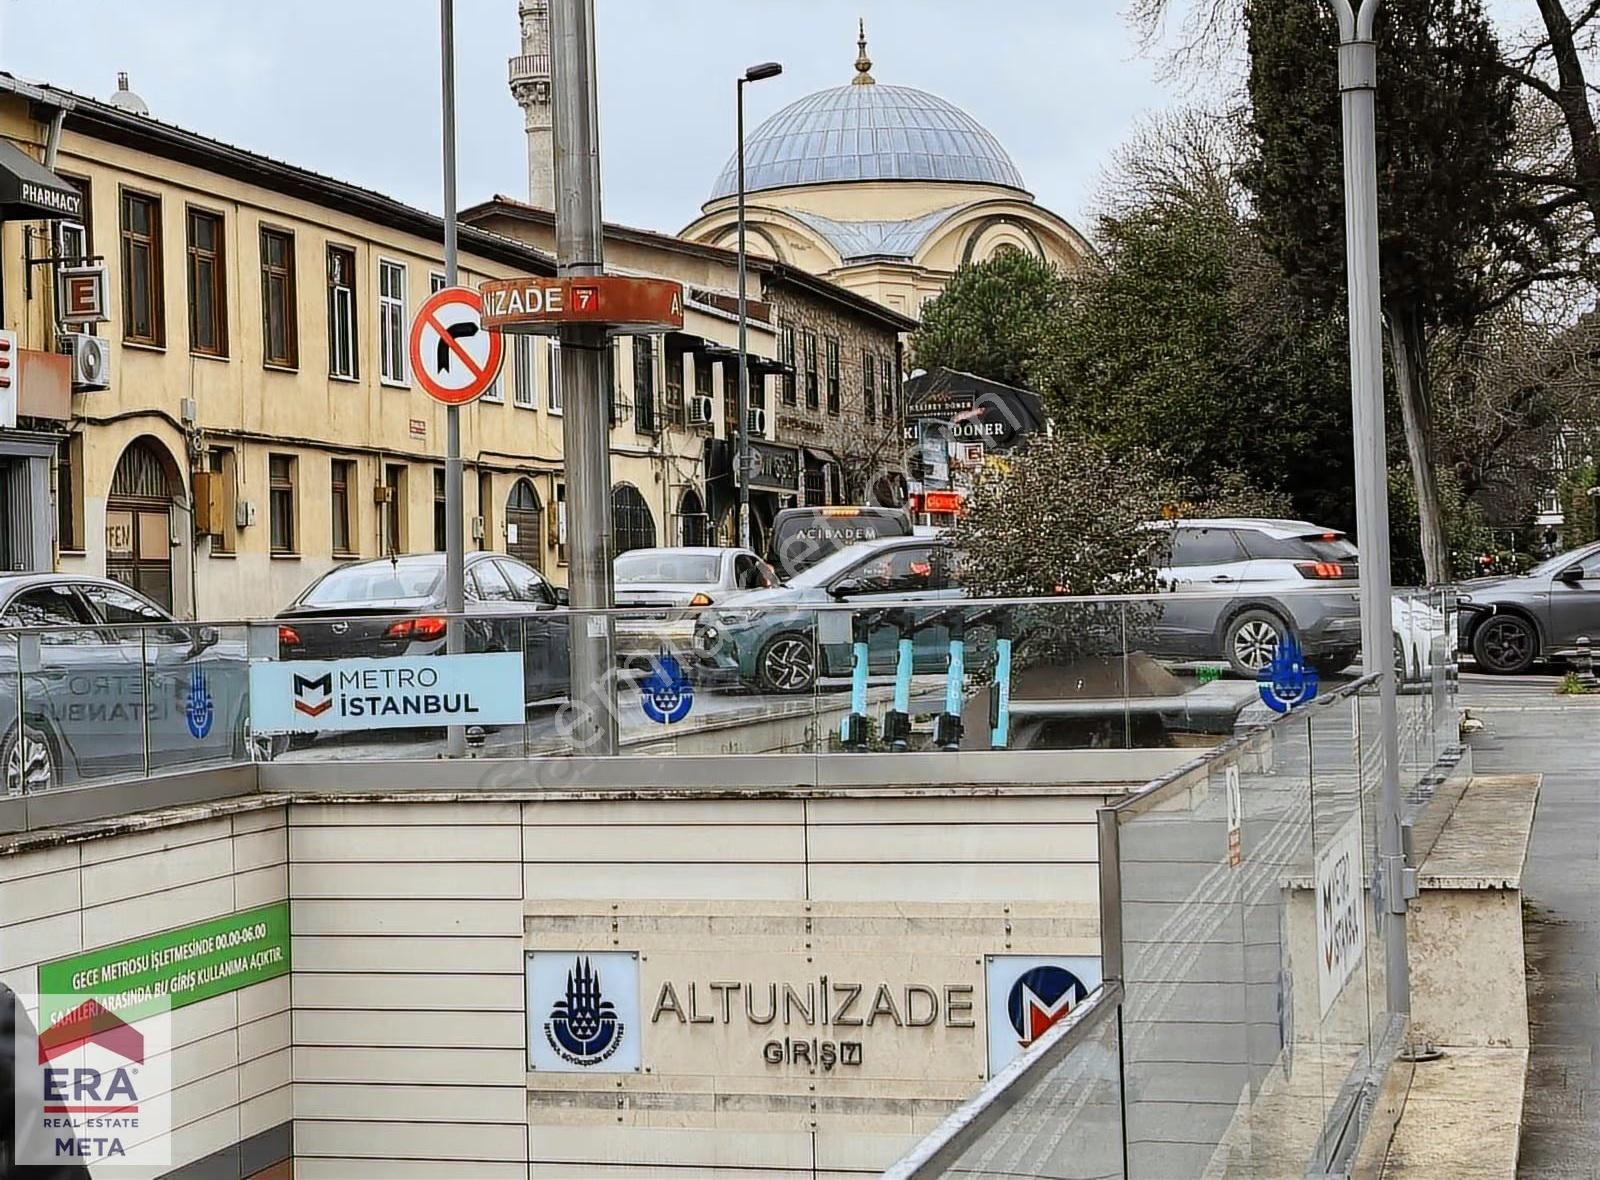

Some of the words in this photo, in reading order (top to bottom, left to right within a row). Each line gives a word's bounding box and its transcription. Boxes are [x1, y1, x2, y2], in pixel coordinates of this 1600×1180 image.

[22, 183, 80, 213] PHARMACY
[340, 667, 438, 690] METRO
[340, 693, 479, 717] İSTANBUL
[73, 971, 98, 990] GECE
[101, 954, 149, 984] METROSU
[215, 923, 266, 949] 00.00-06.00
[101, 989, 151, 1014] ARASINDA
[153, 979, 168, 998] BU
[171, 974, 196, 993] GİRİŞ
[197, 958, 248, 985] KULLANIMA
[651, 975, 975, 1028] ALTUNİZADE
